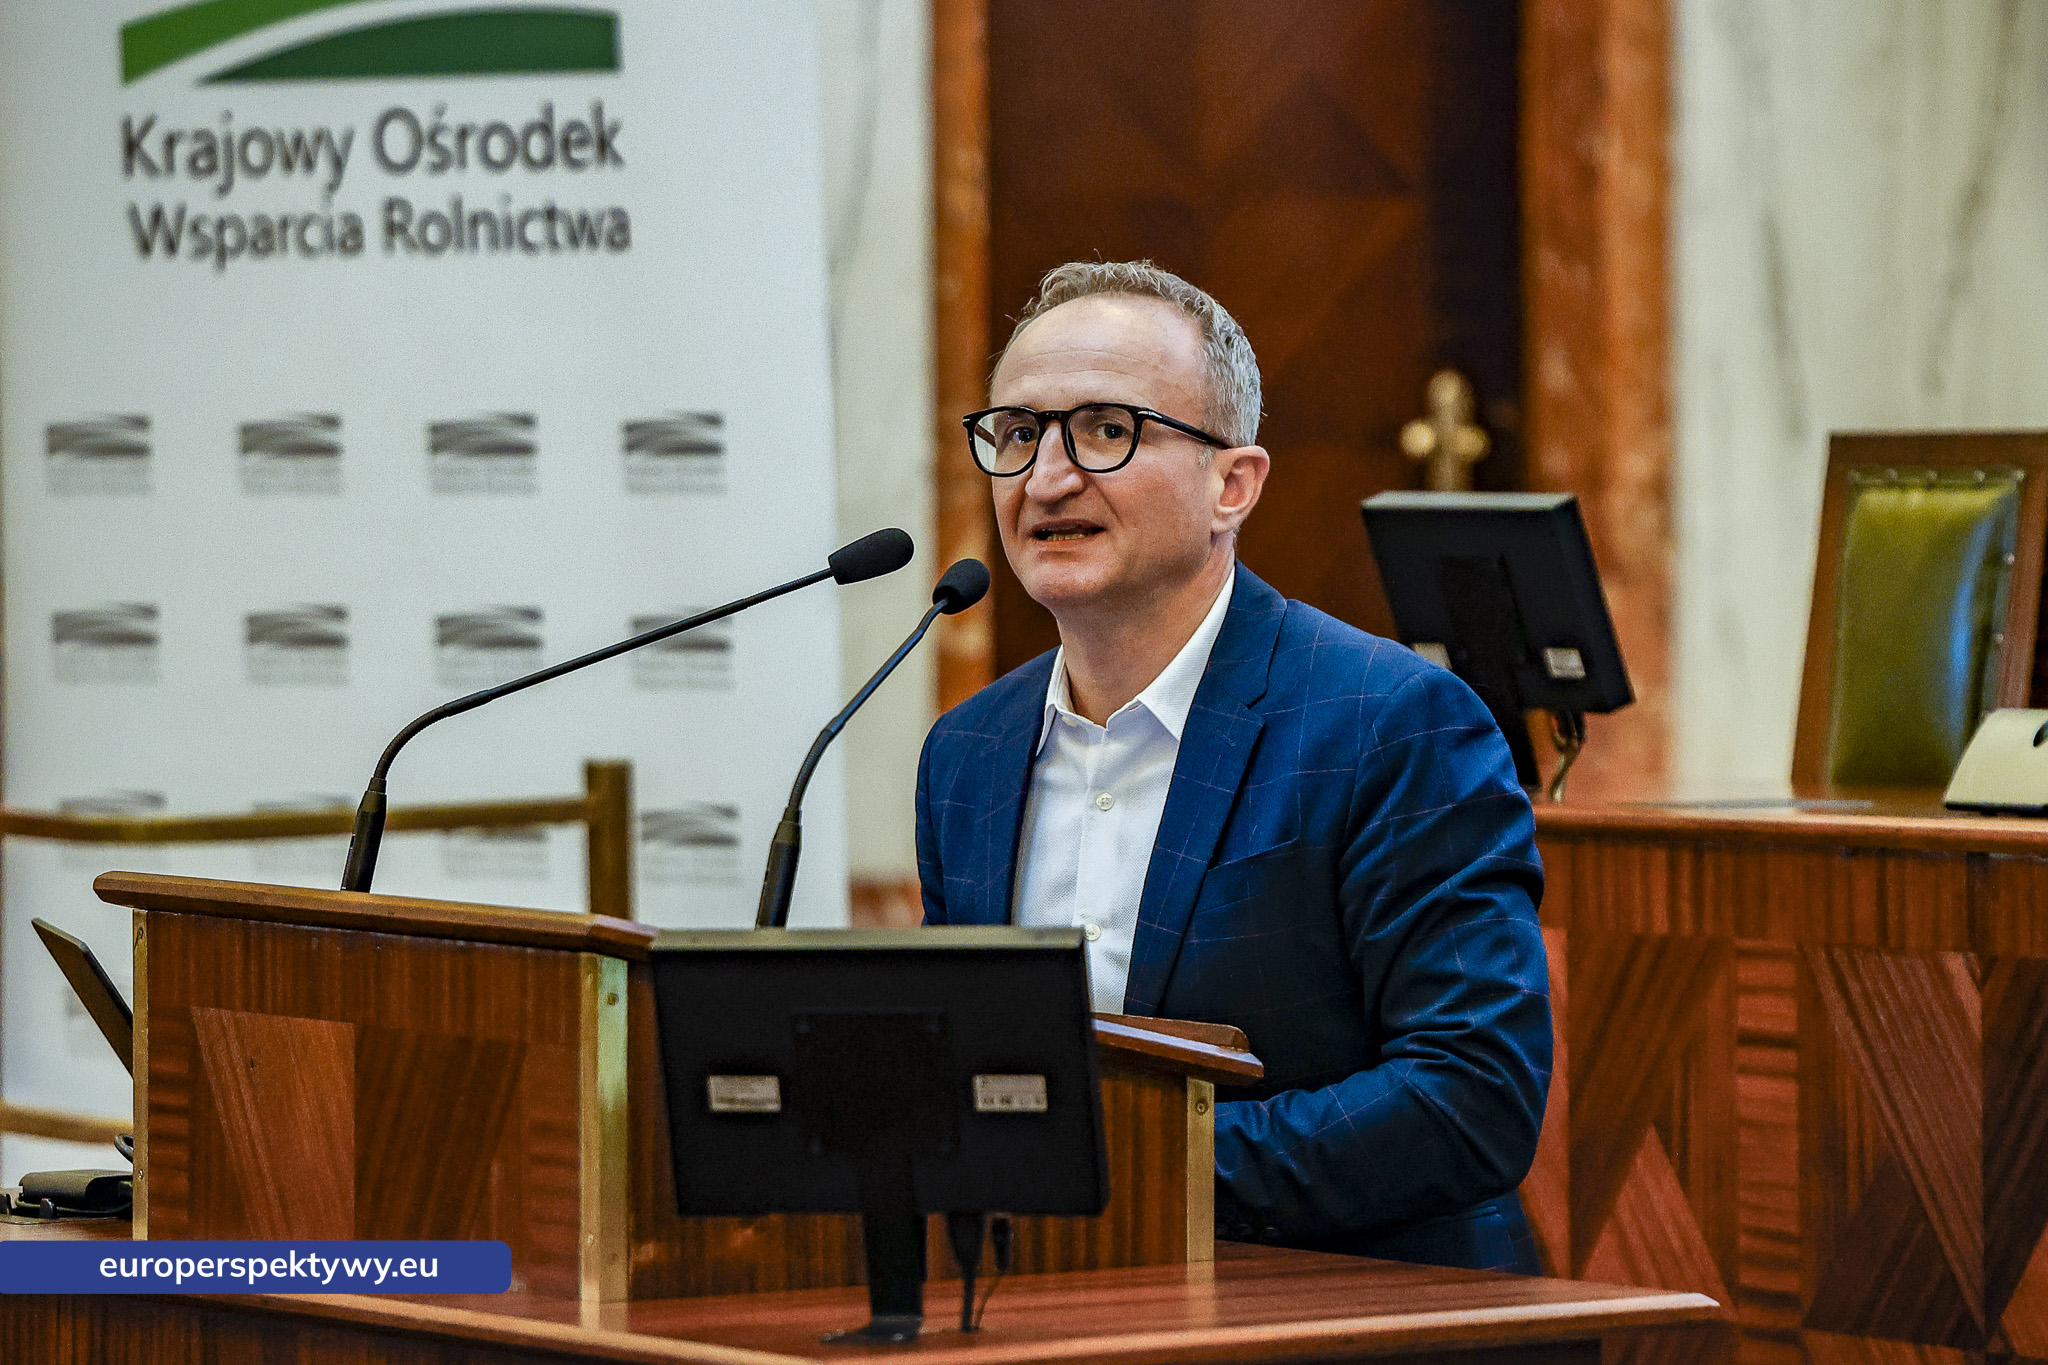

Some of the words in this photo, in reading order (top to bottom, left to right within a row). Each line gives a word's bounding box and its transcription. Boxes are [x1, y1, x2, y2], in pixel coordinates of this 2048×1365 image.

[120, 111, 354, 197] Krajowy
[372, 103, 624, 175] Ośrodek
[127, 202, 365, 270] Wsparcia
[383, 195, 631, 255] Rolnictwa
